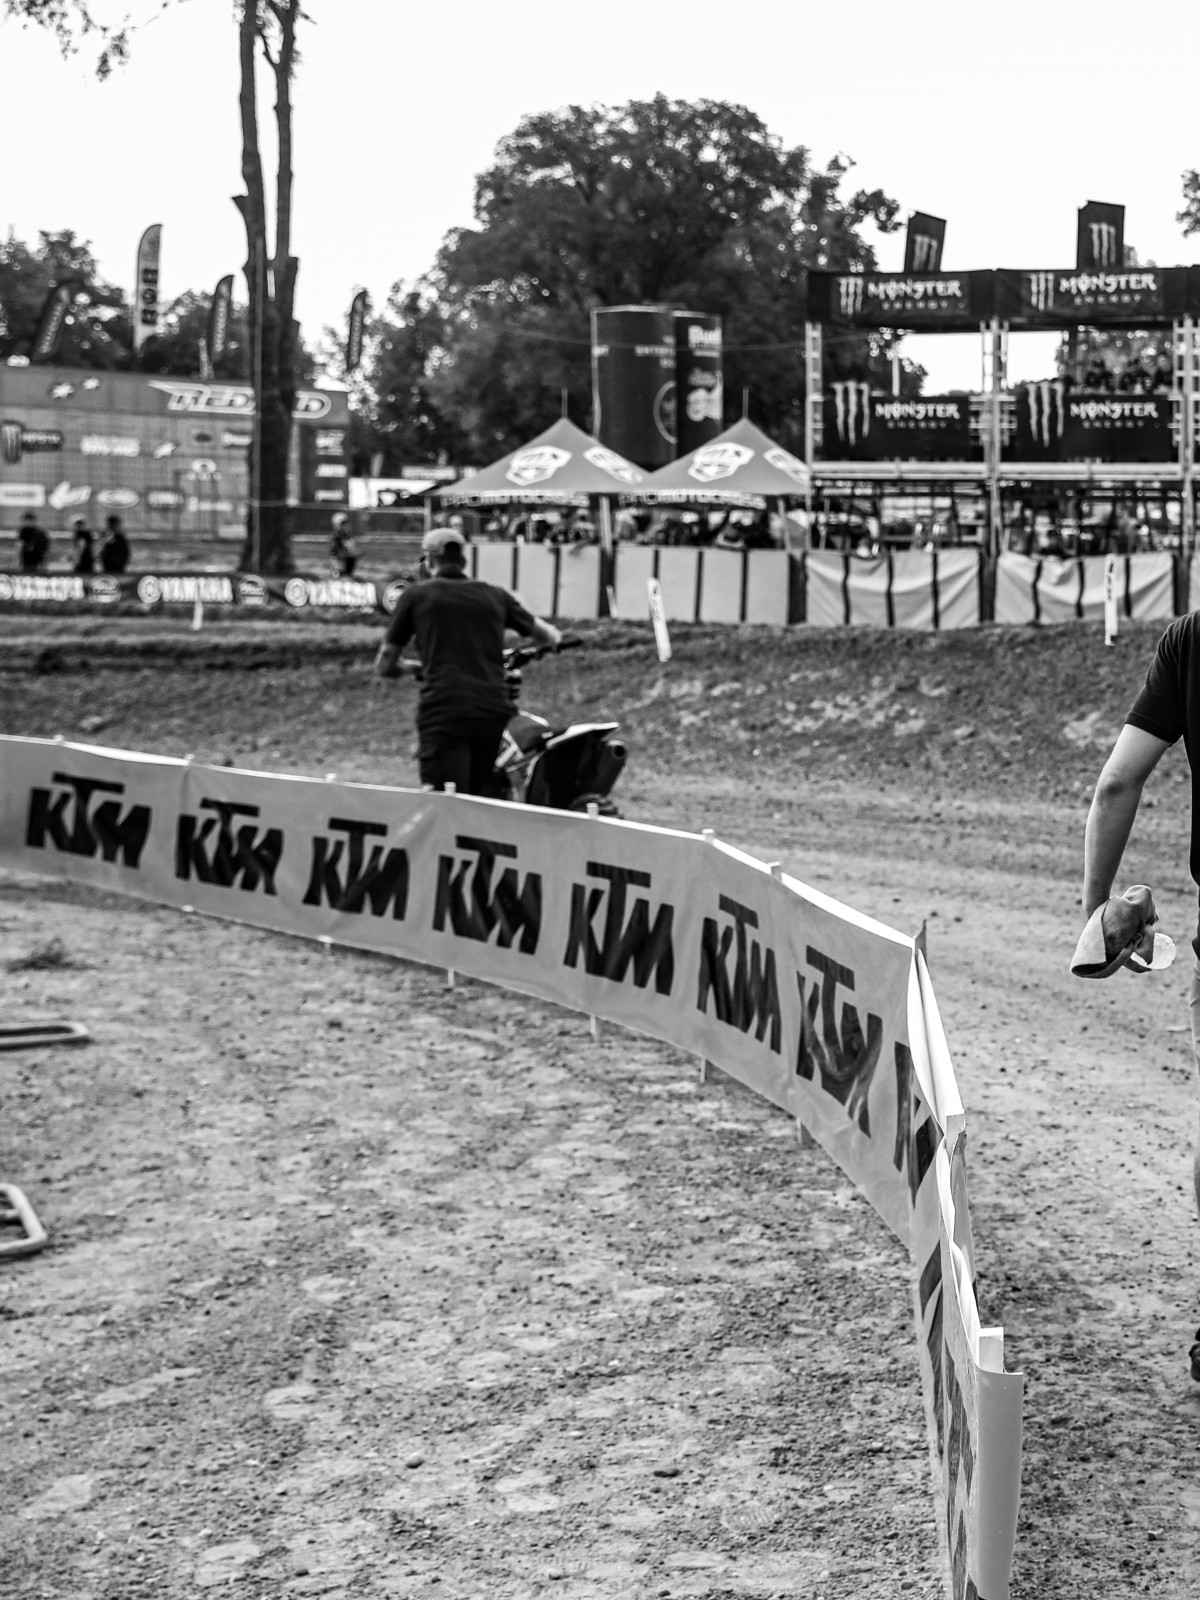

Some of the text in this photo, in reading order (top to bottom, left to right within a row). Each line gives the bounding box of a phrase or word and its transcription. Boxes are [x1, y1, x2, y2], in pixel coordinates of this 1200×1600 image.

[868, 278, 962, 300] MONSTER
[1059, 272, 1157, 294] MONSTER
[875, 400, 960, 420] MONSTER
[1070, 400, 1158, 420] MONSTER
[25, 771, 152, 870] KTM
[175, 797, 284, 897] KTM
[302, 817, 410, 921] KTM
[432, 834, 542, 956] KTM
[563, 860, 674, 997] KTM
[696, 893, 782, 1055] KTM
[796, 944, 883, 1139] KTM
